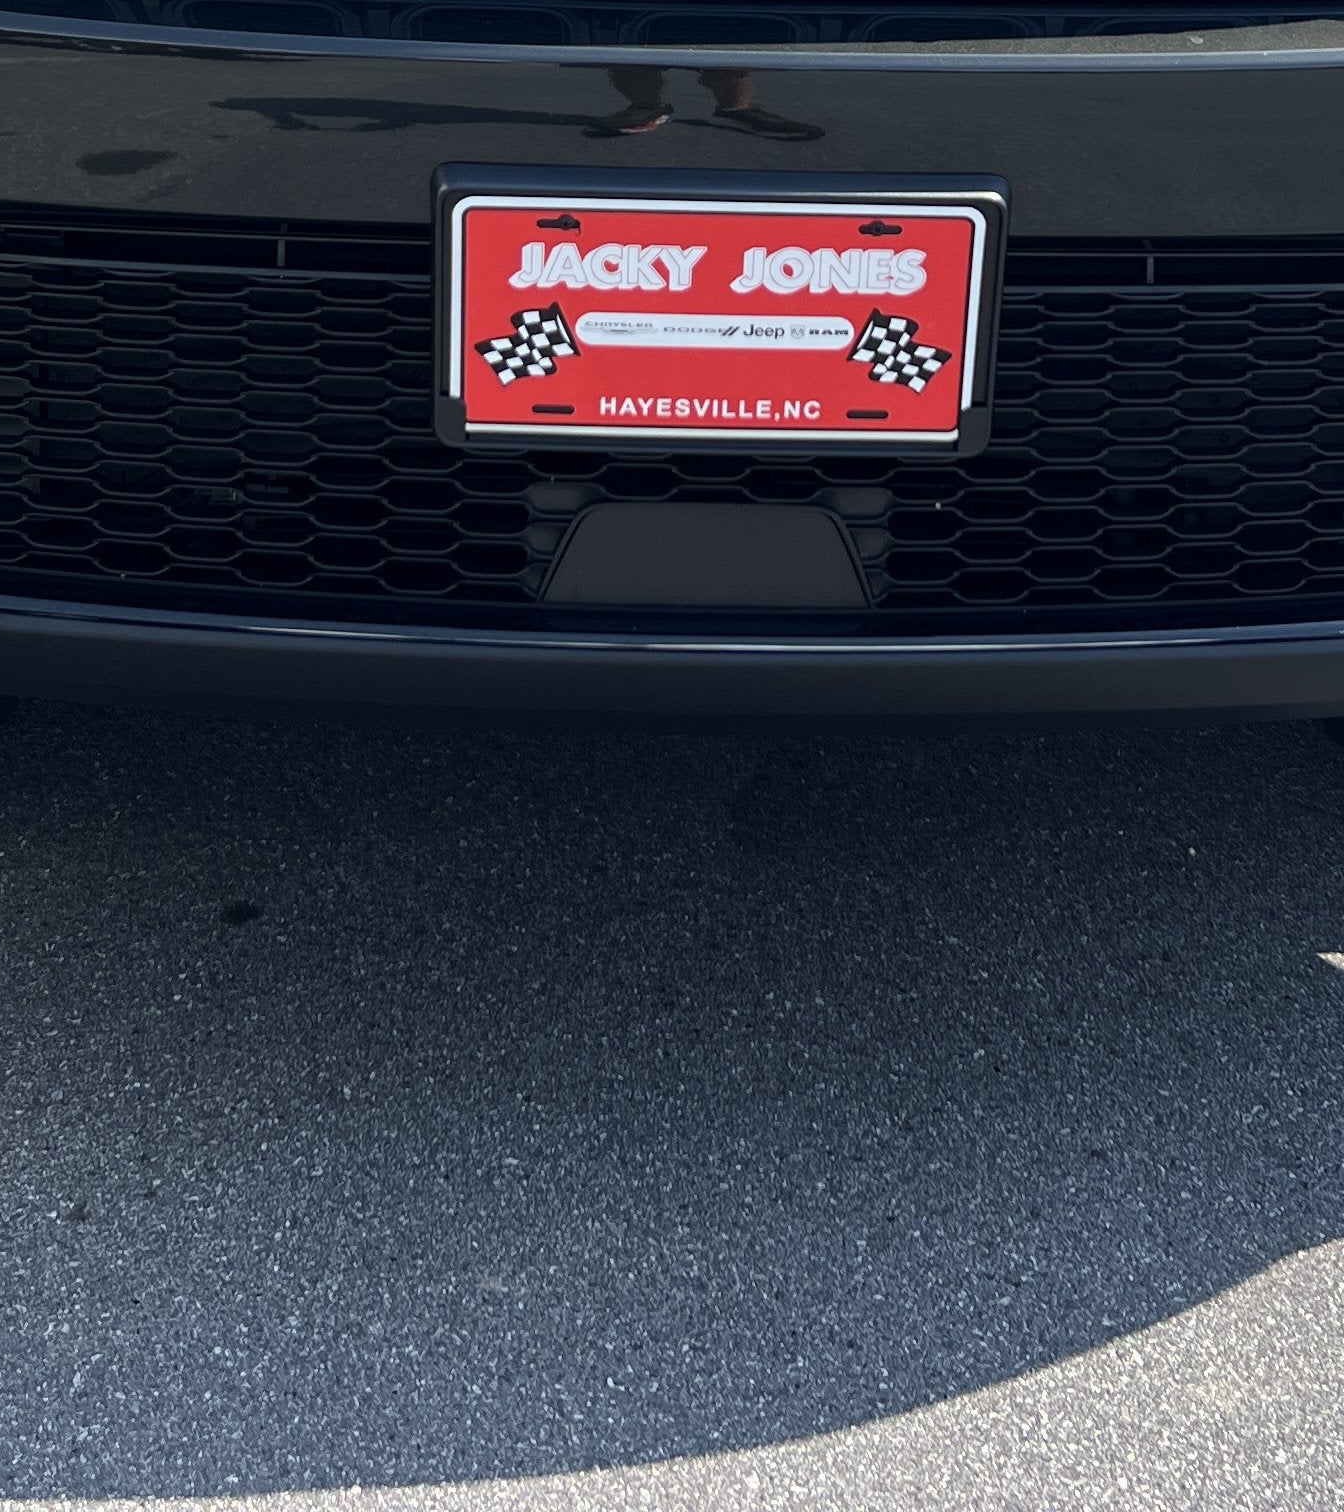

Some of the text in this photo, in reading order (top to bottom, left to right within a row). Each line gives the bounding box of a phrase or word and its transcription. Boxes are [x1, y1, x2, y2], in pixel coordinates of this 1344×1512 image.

[509, 242, 926, 295] JACKY JONES
[584, 320, 654, 330] CHRYSLER
[743, 324, 785, 340] Jeep
[599, 396, 821, 420] HAYESVILLE,NC
